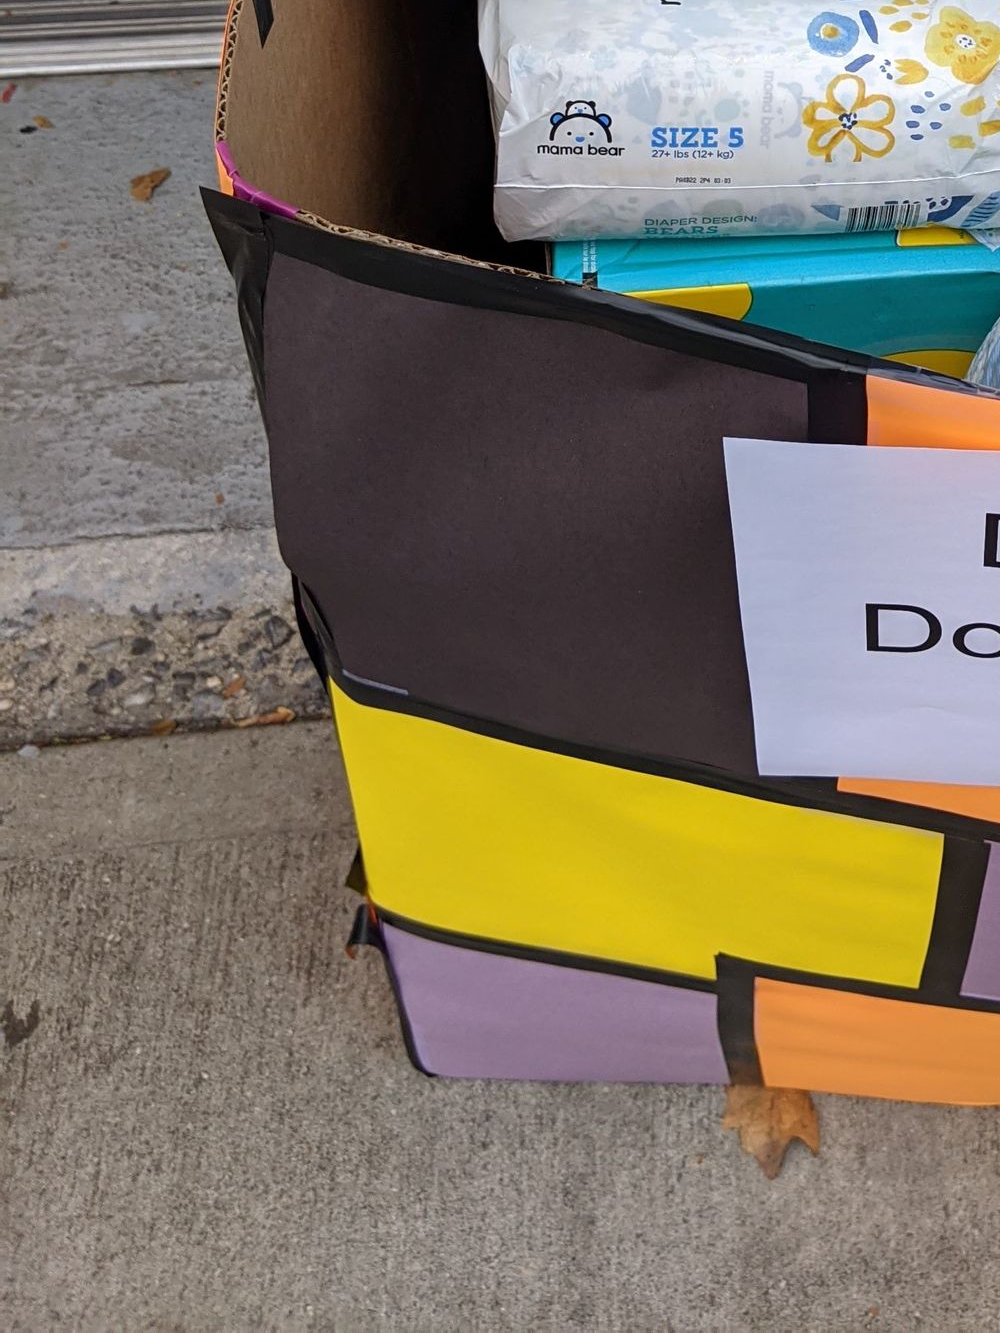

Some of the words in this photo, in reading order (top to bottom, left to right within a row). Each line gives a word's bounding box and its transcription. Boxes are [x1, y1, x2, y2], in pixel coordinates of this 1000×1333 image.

[651, 126, 719, 148] SIZE
[727, 127, 744, 148] 5
[537, 143, 584, 155] mama
[587, 142, 625, 157] bear
[651, 149, 671, 158] 27+
[673, 149, 689, 158] lbs
[692, 149, 714, 159] (12+
[716, 149, 734, 159] kg)
[644, 218, 698, 226] DIAPER
[701, 215, 758, 225] DESIGN:
[644, 225, 719, 235] BEARS
